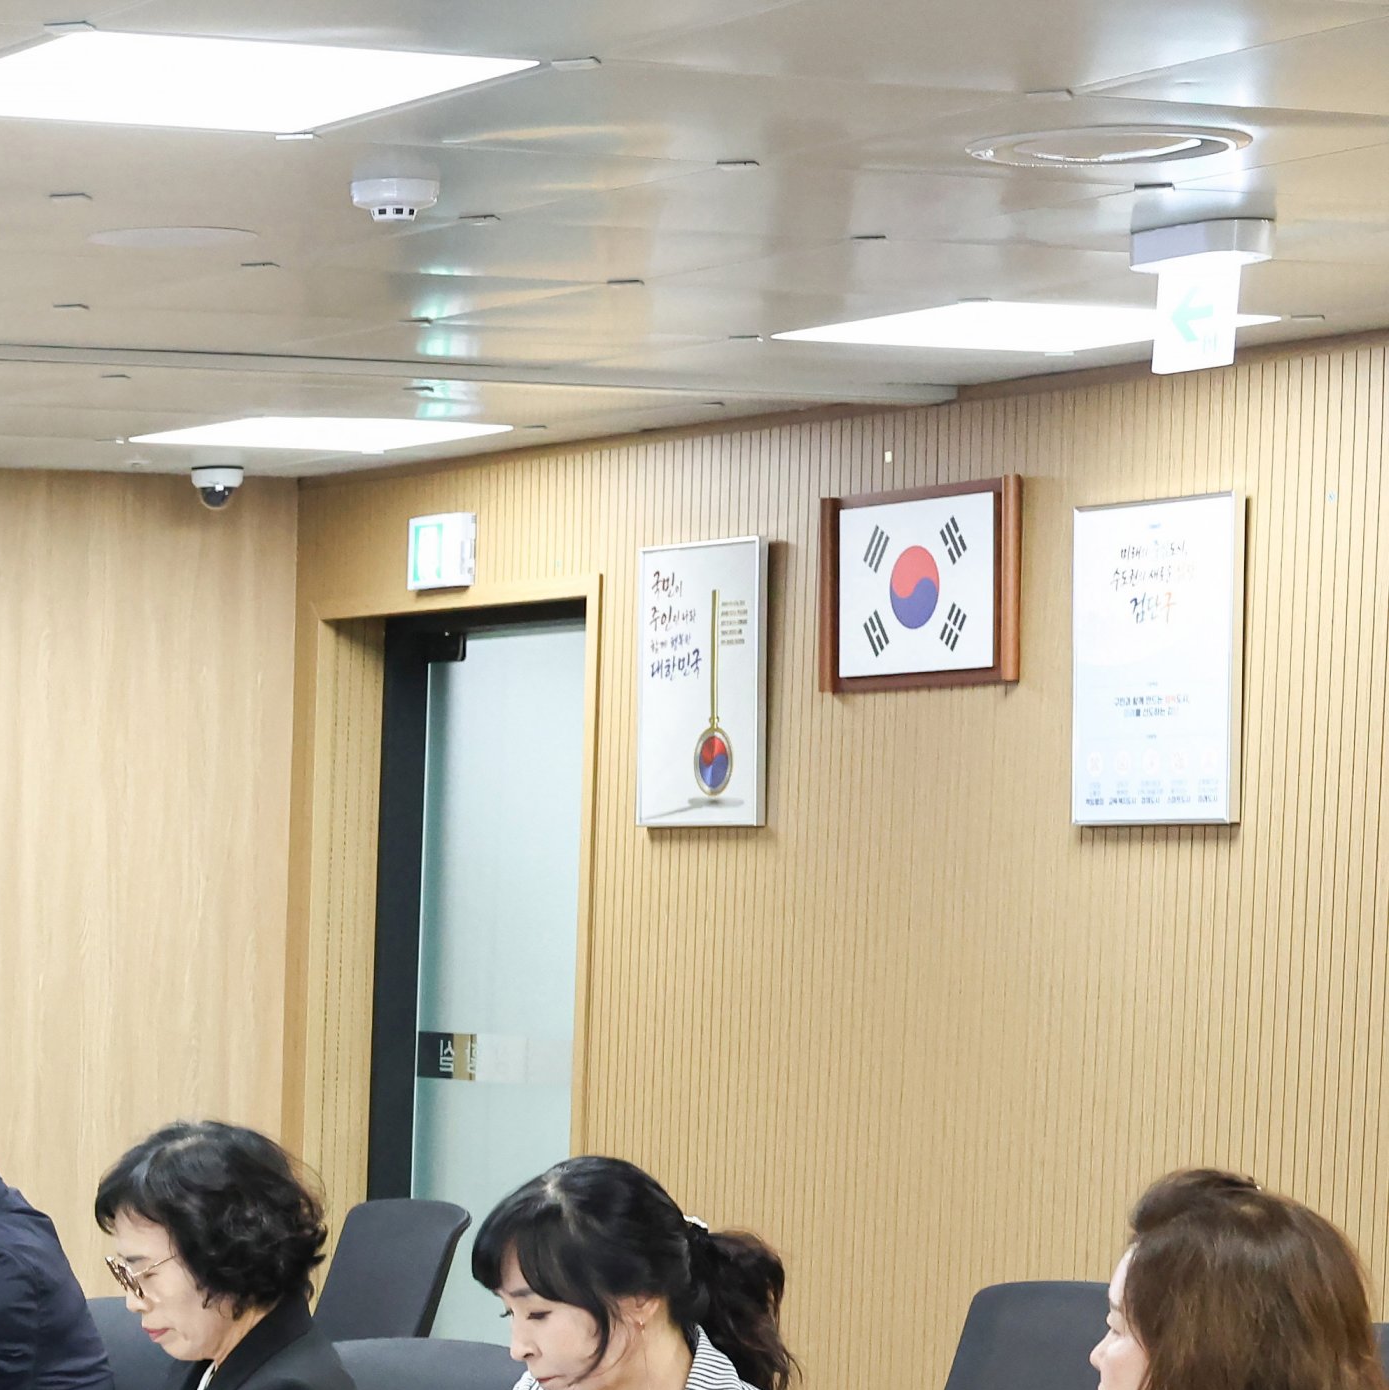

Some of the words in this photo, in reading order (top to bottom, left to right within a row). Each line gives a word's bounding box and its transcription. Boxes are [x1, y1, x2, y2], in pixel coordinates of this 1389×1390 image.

[651, 570, 683, 598] 국민이
[1129, 591, 1178, 624] 검단구
[650, 647, 702, 681] 대한민국
